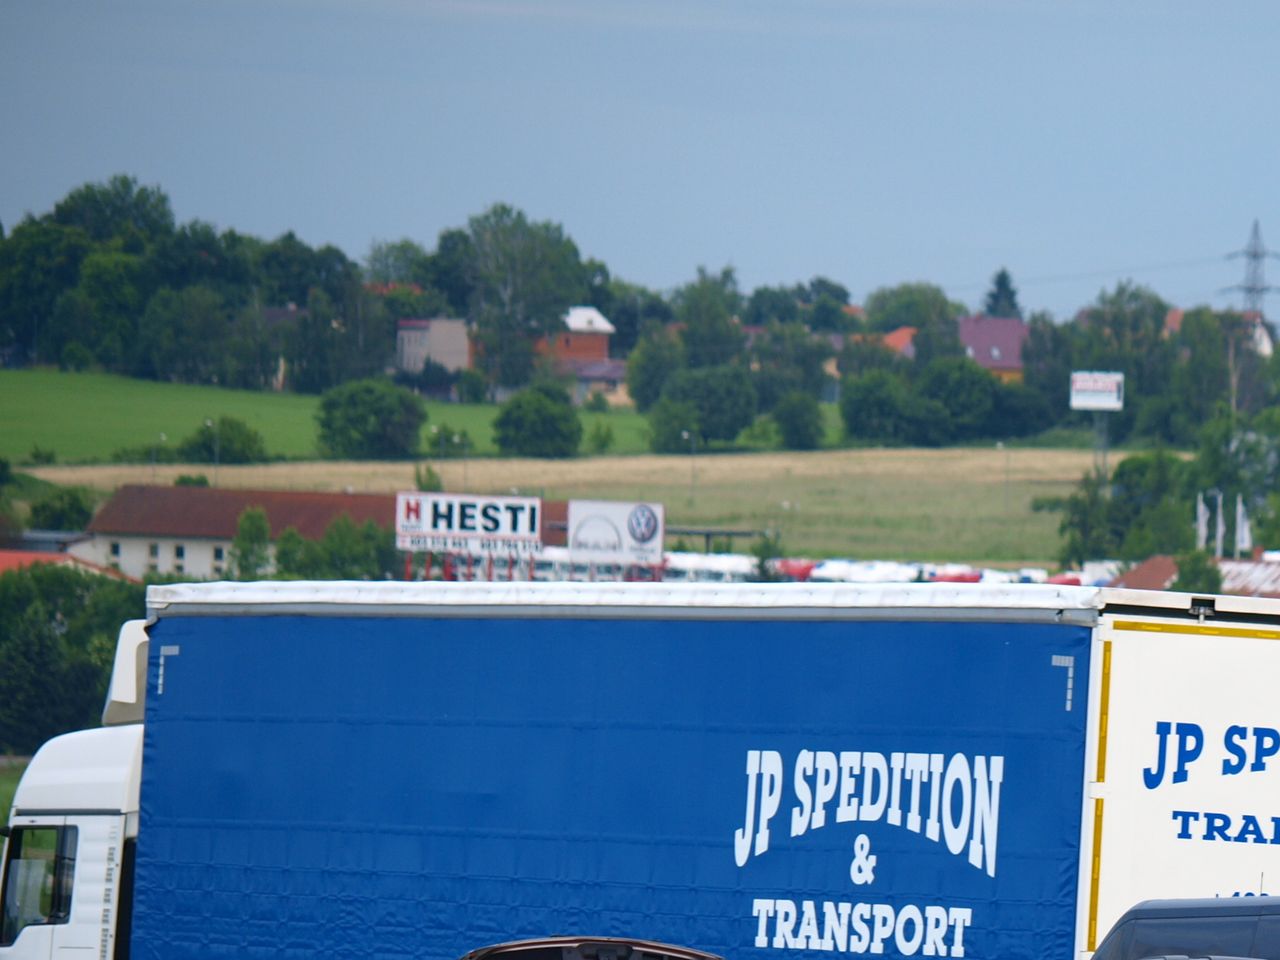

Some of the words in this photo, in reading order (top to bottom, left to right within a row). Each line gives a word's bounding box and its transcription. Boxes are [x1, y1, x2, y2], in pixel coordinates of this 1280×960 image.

[431, 501, 536, 533] HESTI
[1143, 721, 1204, 790] JP
[735, 750, 783, 867] JP
[791, 749, 1004, 878] SPEDITION
[850, 834, 877, 885] &
[752, 898, 972, 958] TRANSPORT
